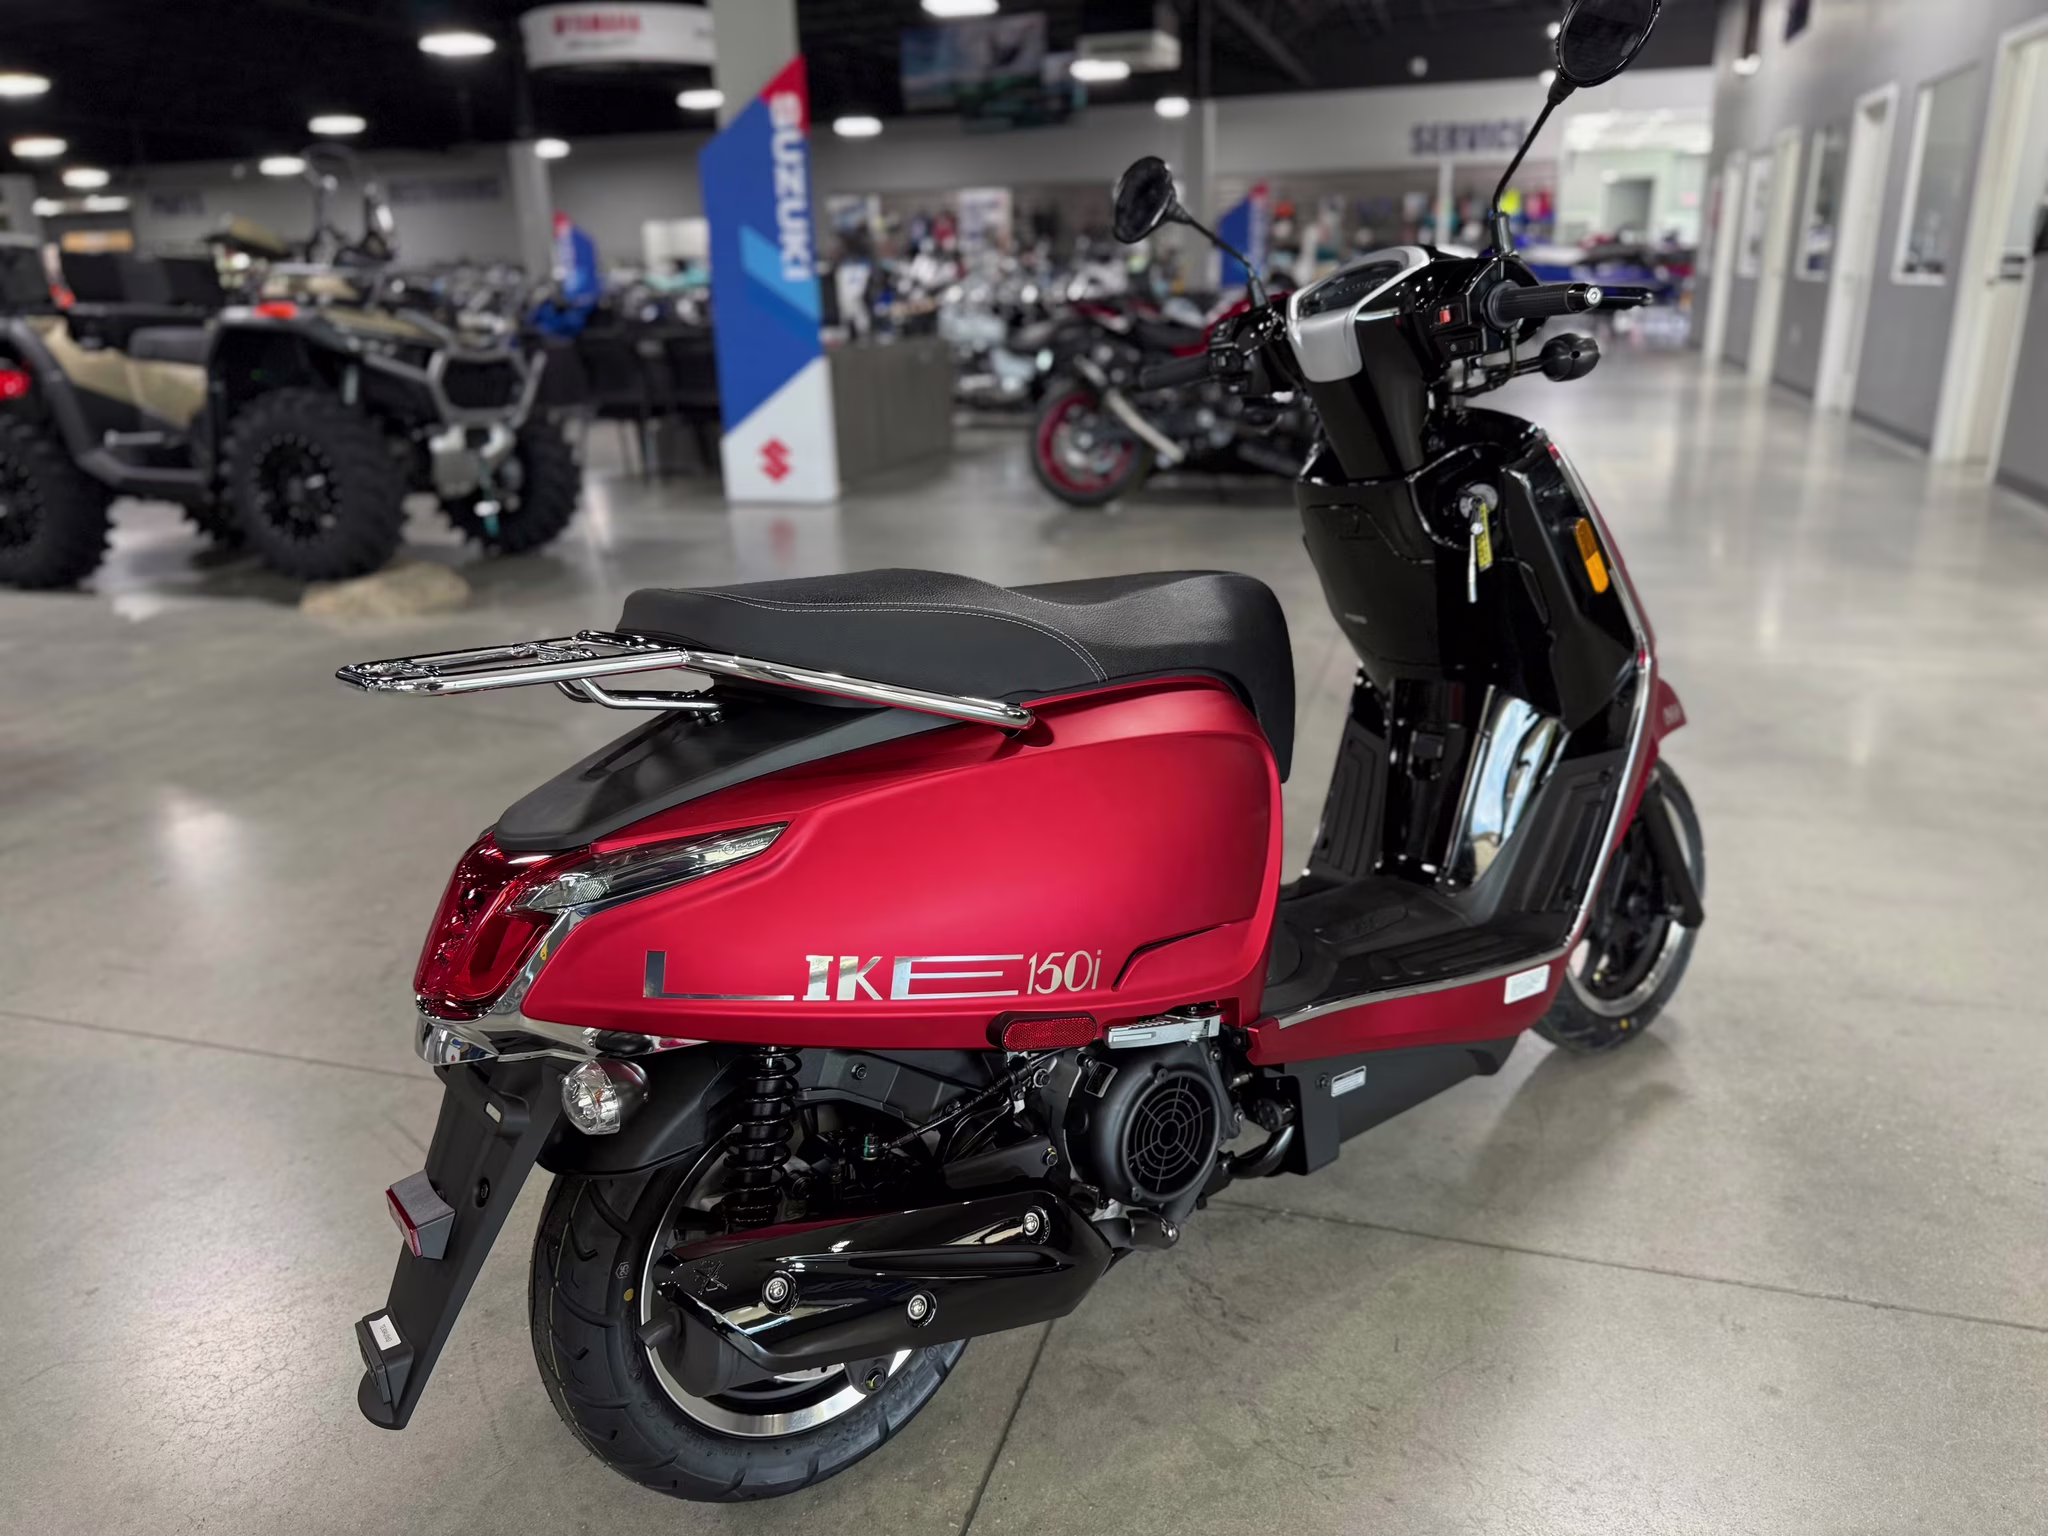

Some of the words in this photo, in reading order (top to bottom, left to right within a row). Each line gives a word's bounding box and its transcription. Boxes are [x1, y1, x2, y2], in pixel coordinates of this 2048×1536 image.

[769, 92, 811, 282] SUZUKI
[642, 949, 1024, 1001] LIKE
[1026, 949, 1102, 996] 150i
